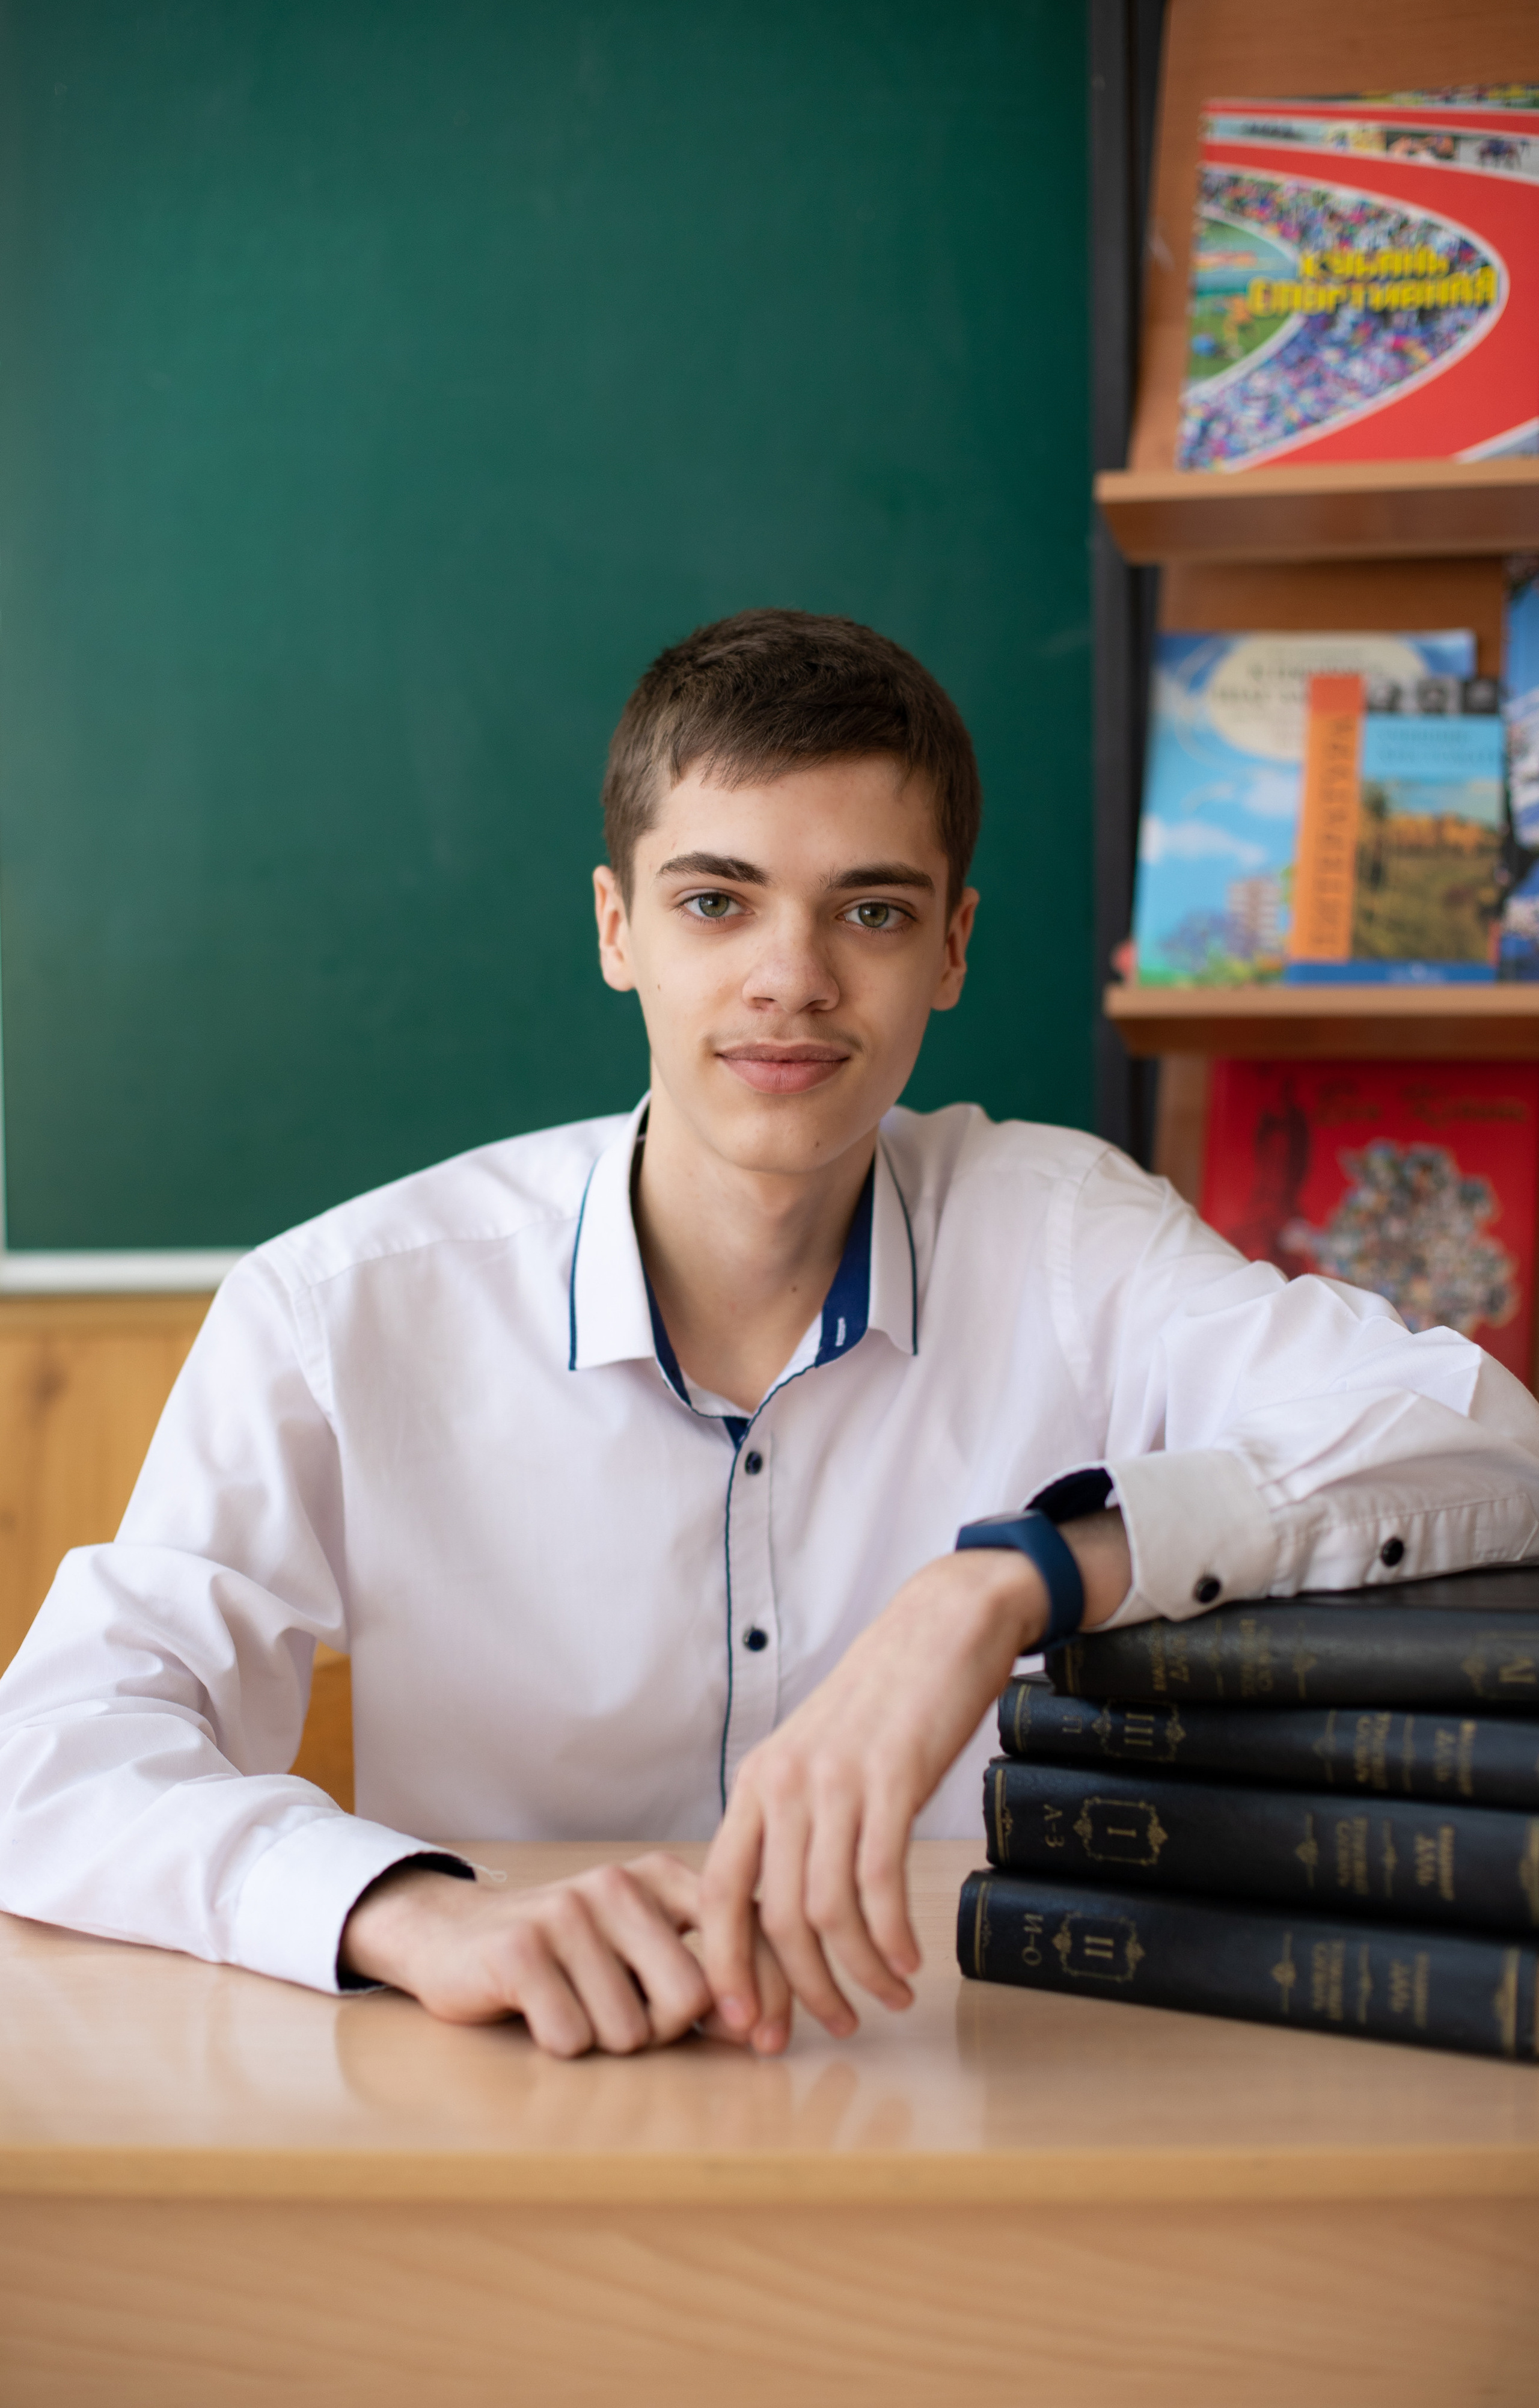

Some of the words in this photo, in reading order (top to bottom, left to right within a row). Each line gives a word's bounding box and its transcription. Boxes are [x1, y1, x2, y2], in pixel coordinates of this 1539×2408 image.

[1062, 1715, 1082, 1734] П
[1124, 1712, 1154, 1745] III
[1107, 1826, 1137, 1838] I
[1084, 1935, 1114, 1959] II
